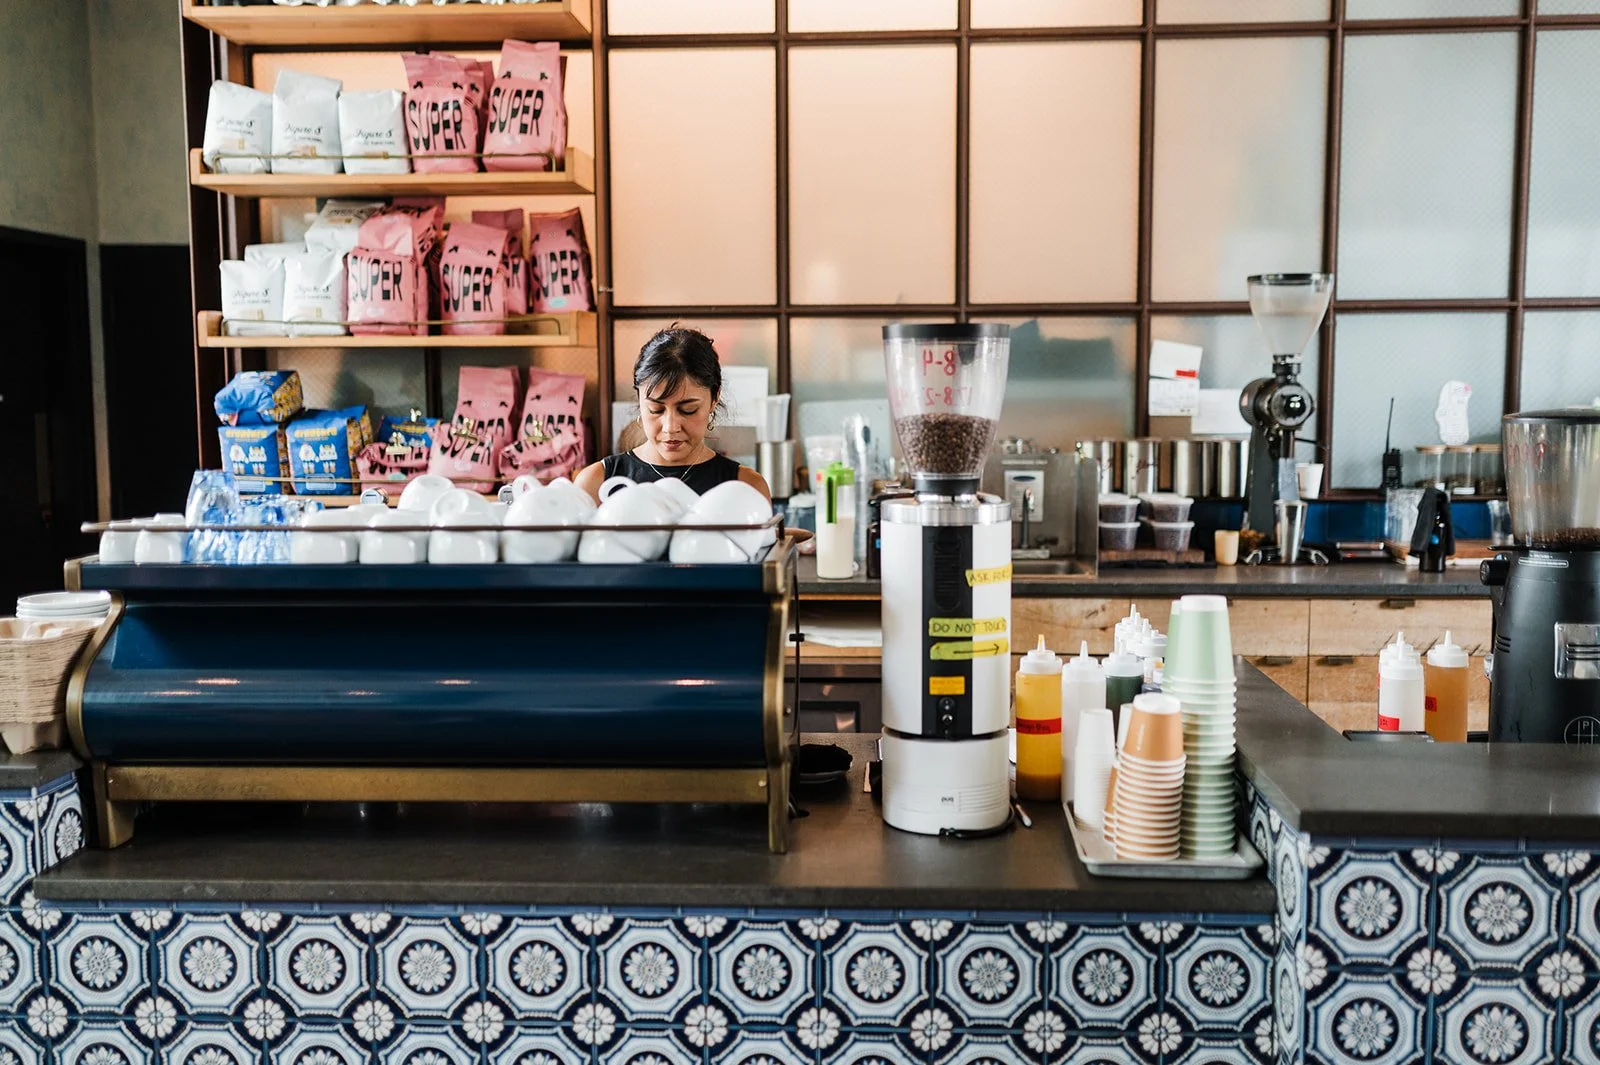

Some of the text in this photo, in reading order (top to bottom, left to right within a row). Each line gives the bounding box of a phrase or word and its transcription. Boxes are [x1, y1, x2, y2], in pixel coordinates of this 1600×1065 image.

[409, 99, 466, 151] SUPER
[489, 87, 544, 137] SUPER
[351, 255, 403, 301] SUPER
[442, 263, 493, 313] SUPER
[531, 250, 582, 301] SUPER
[932, 622, 950, 633] DO
[955, 622, 979, 634] NOT
